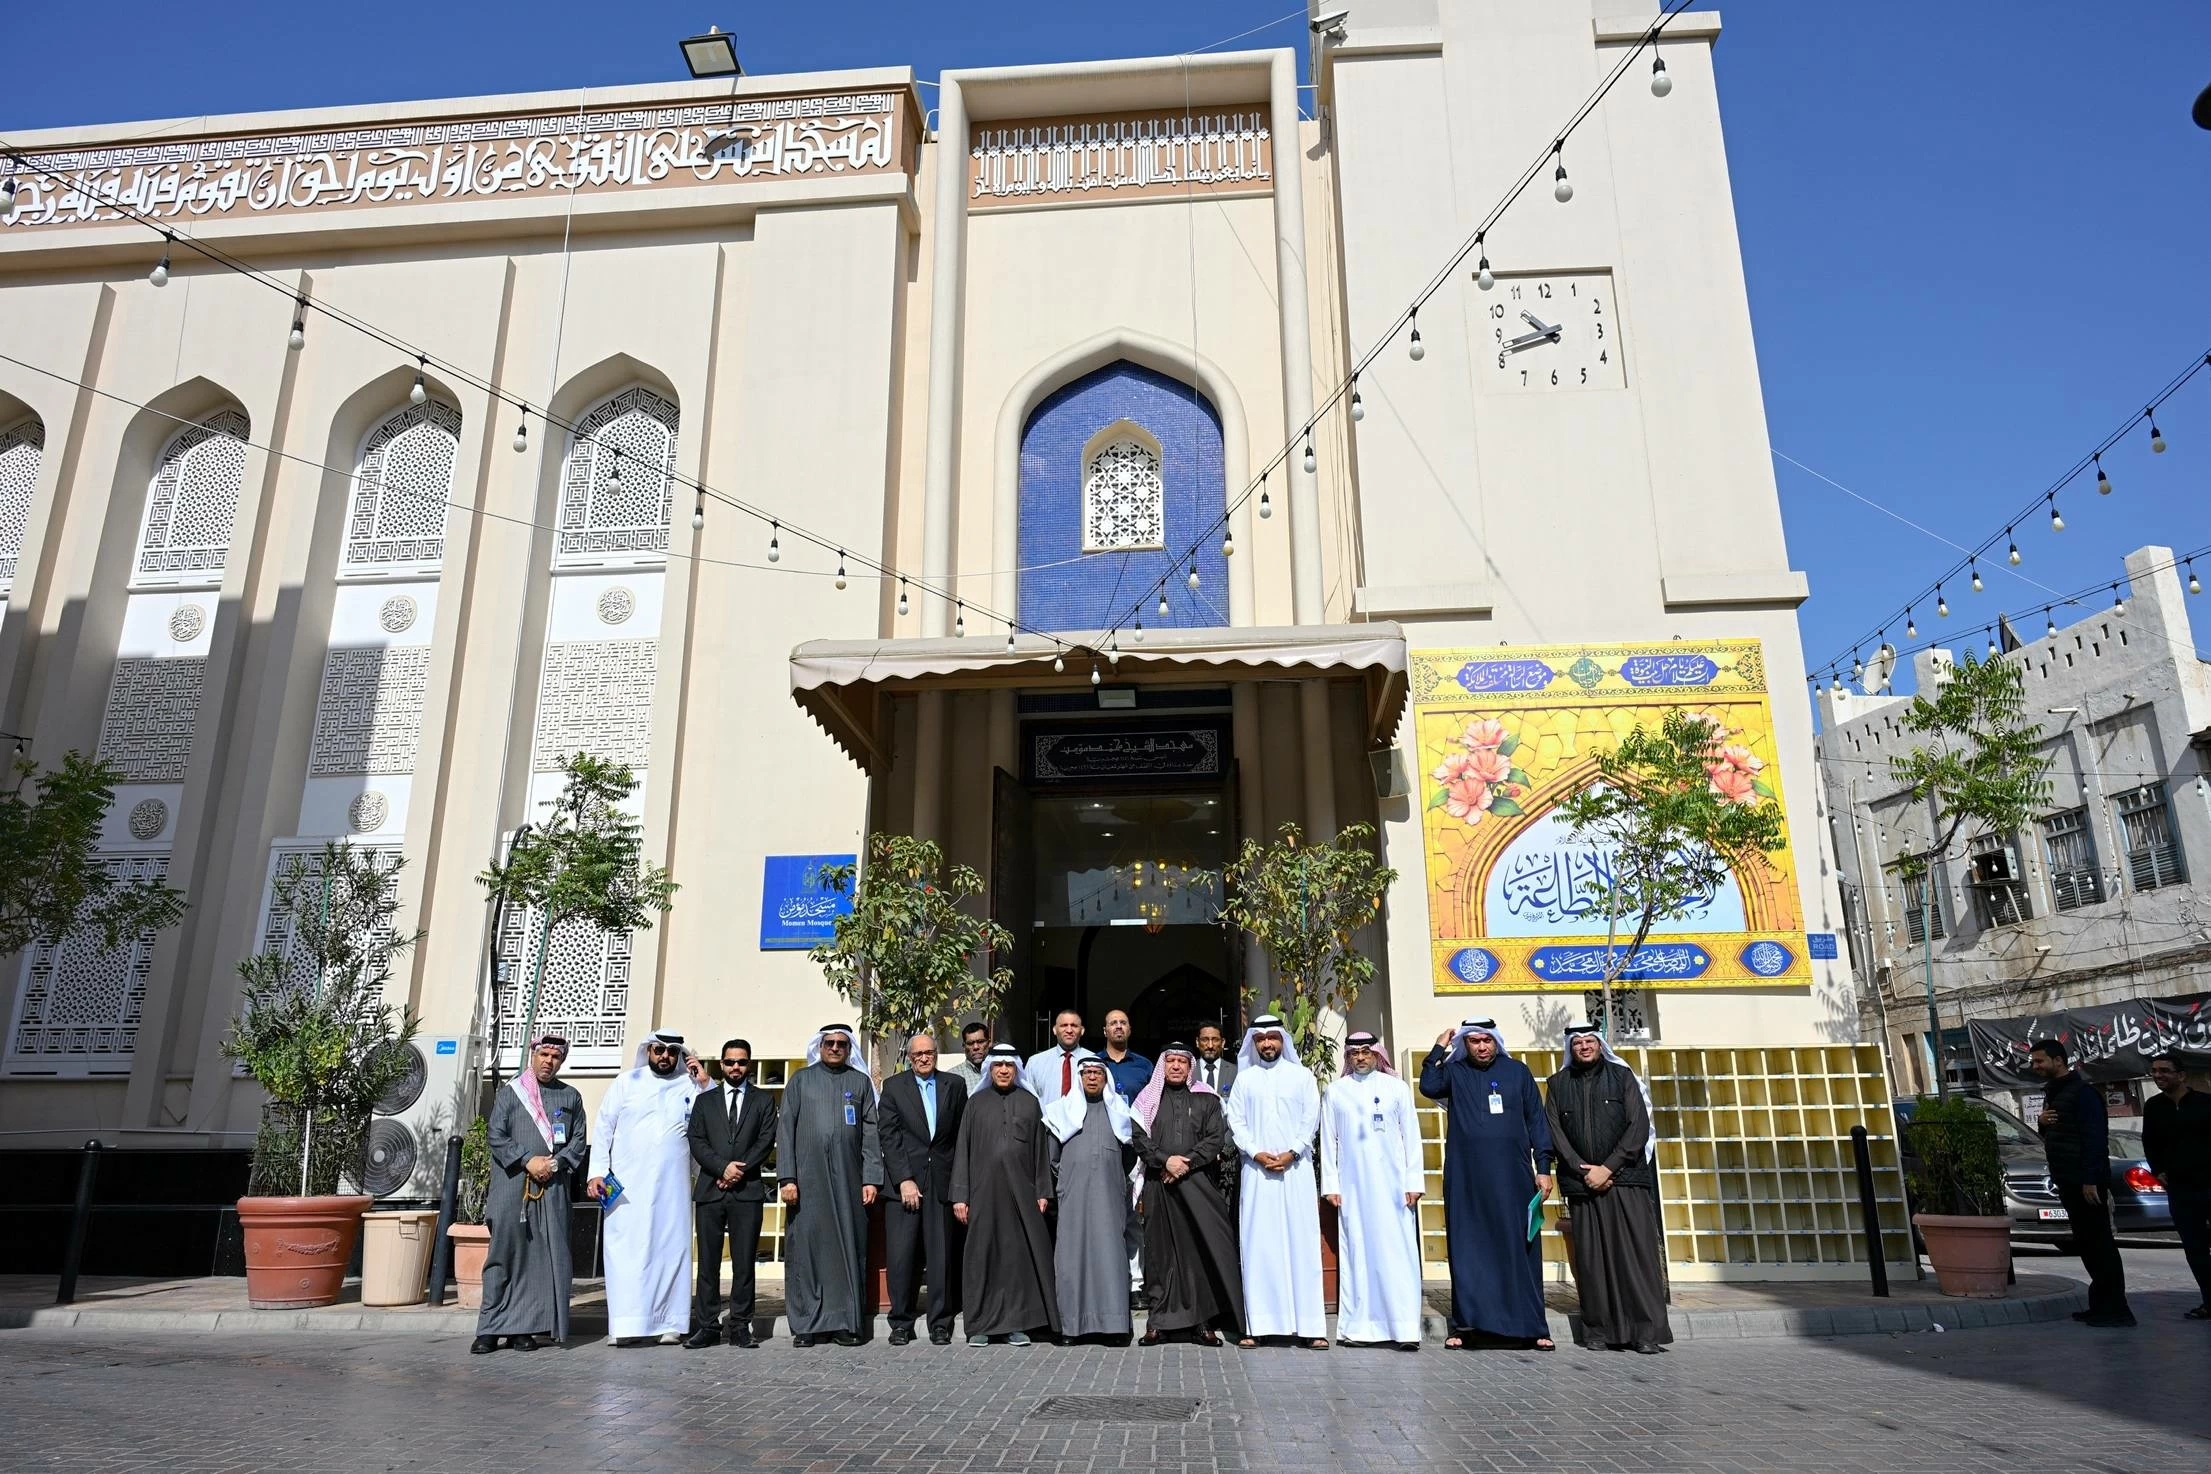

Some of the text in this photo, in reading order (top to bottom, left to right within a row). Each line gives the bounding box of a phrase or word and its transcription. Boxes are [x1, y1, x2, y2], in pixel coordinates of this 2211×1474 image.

[1511, 283, 1521, 300] 11
[1538, 283, 1551, 298] 12
[1571, 282, 1576, 297] 1
[1490, 304, 1504, 319] 10
[1594, 298, 1601, 314] 2
[1496, 328, 1502, 343] 9
[1598, 323, 1603, 339] 3
[1600, 349, 1607, 364] 4
[1521, 370, 1527, 386] 7
[1551, 370, 1558, 385] 6
[1581, 368, 1586, 384] 5
[2048, 1209, 2068, 1218] 6303
